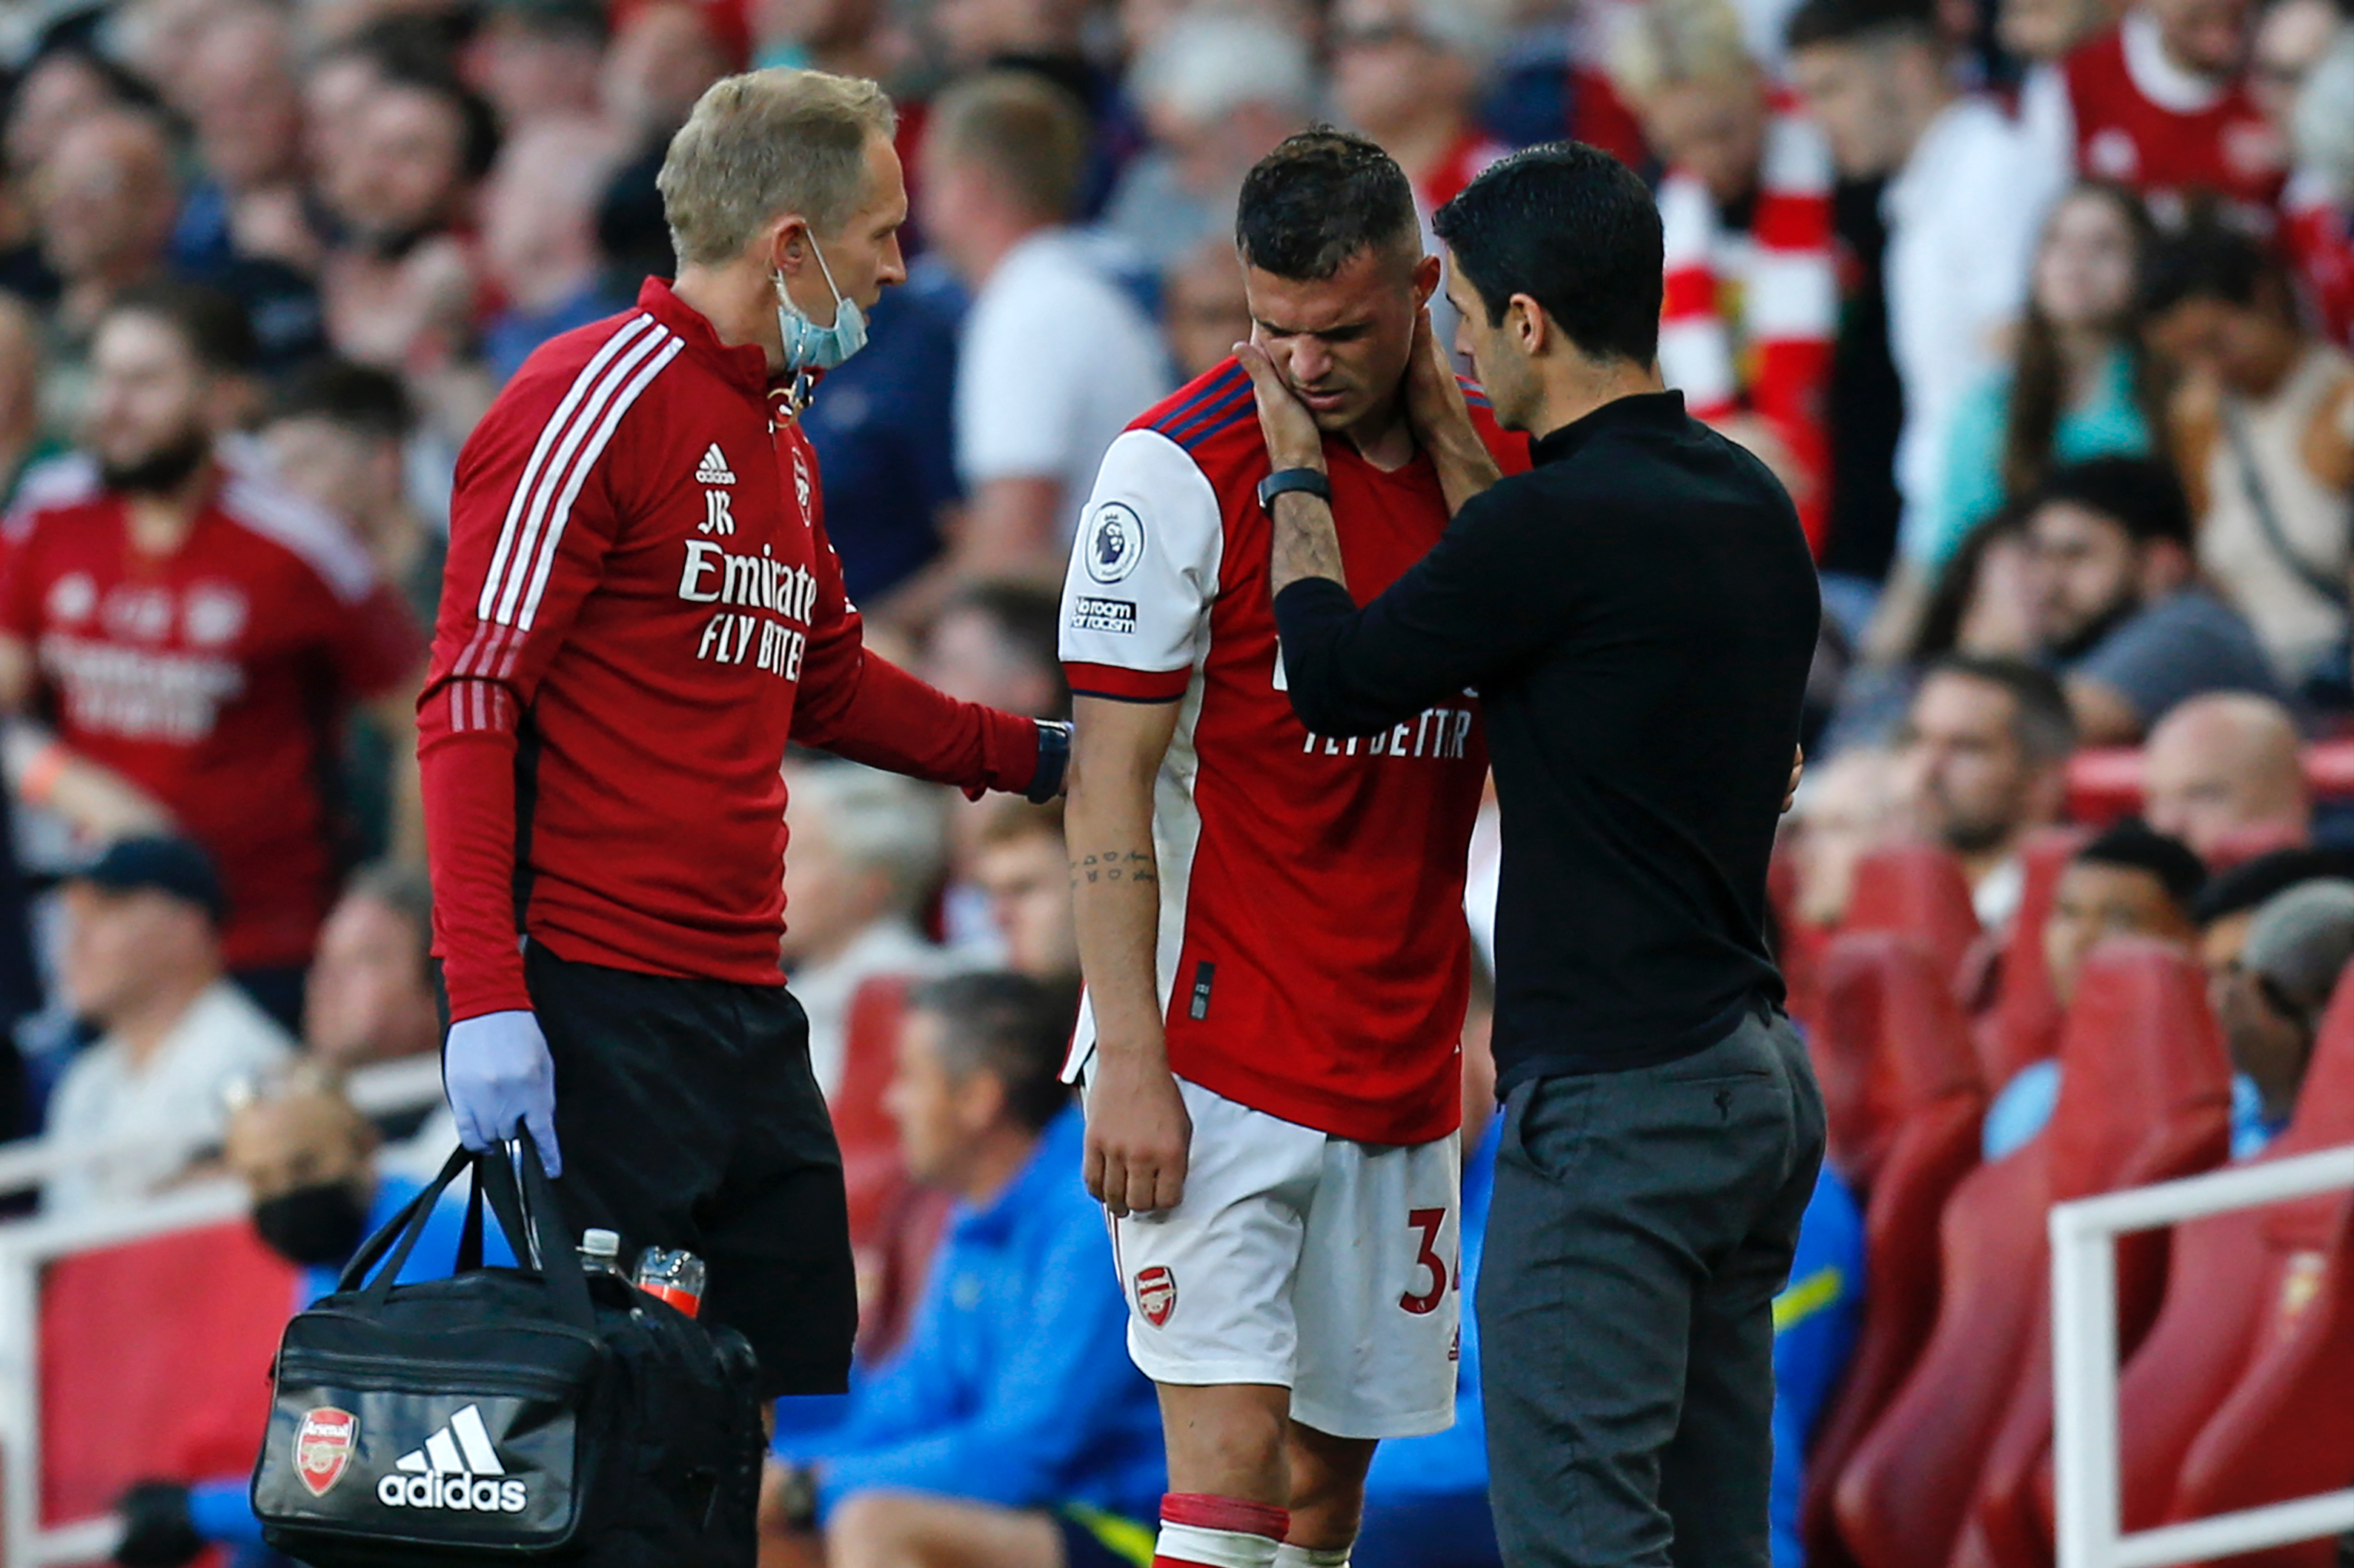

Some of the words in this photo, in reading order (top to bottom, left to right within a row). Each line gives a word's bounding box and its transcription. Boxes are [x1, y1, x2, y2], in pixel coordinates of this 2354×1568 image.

[697, 489, 735, 535] JR
[677, 539, 817, 626] Emirate
[1087, 617, 1135, 632] racism
[1090, 600, 1131, 619] room
[697, 614, 756, 664] FLY
[757, 618, 806, 683] BTTE
[1399, 1208, 1460, 1315] 3
[377, 1469, 528, 1512] adidas
